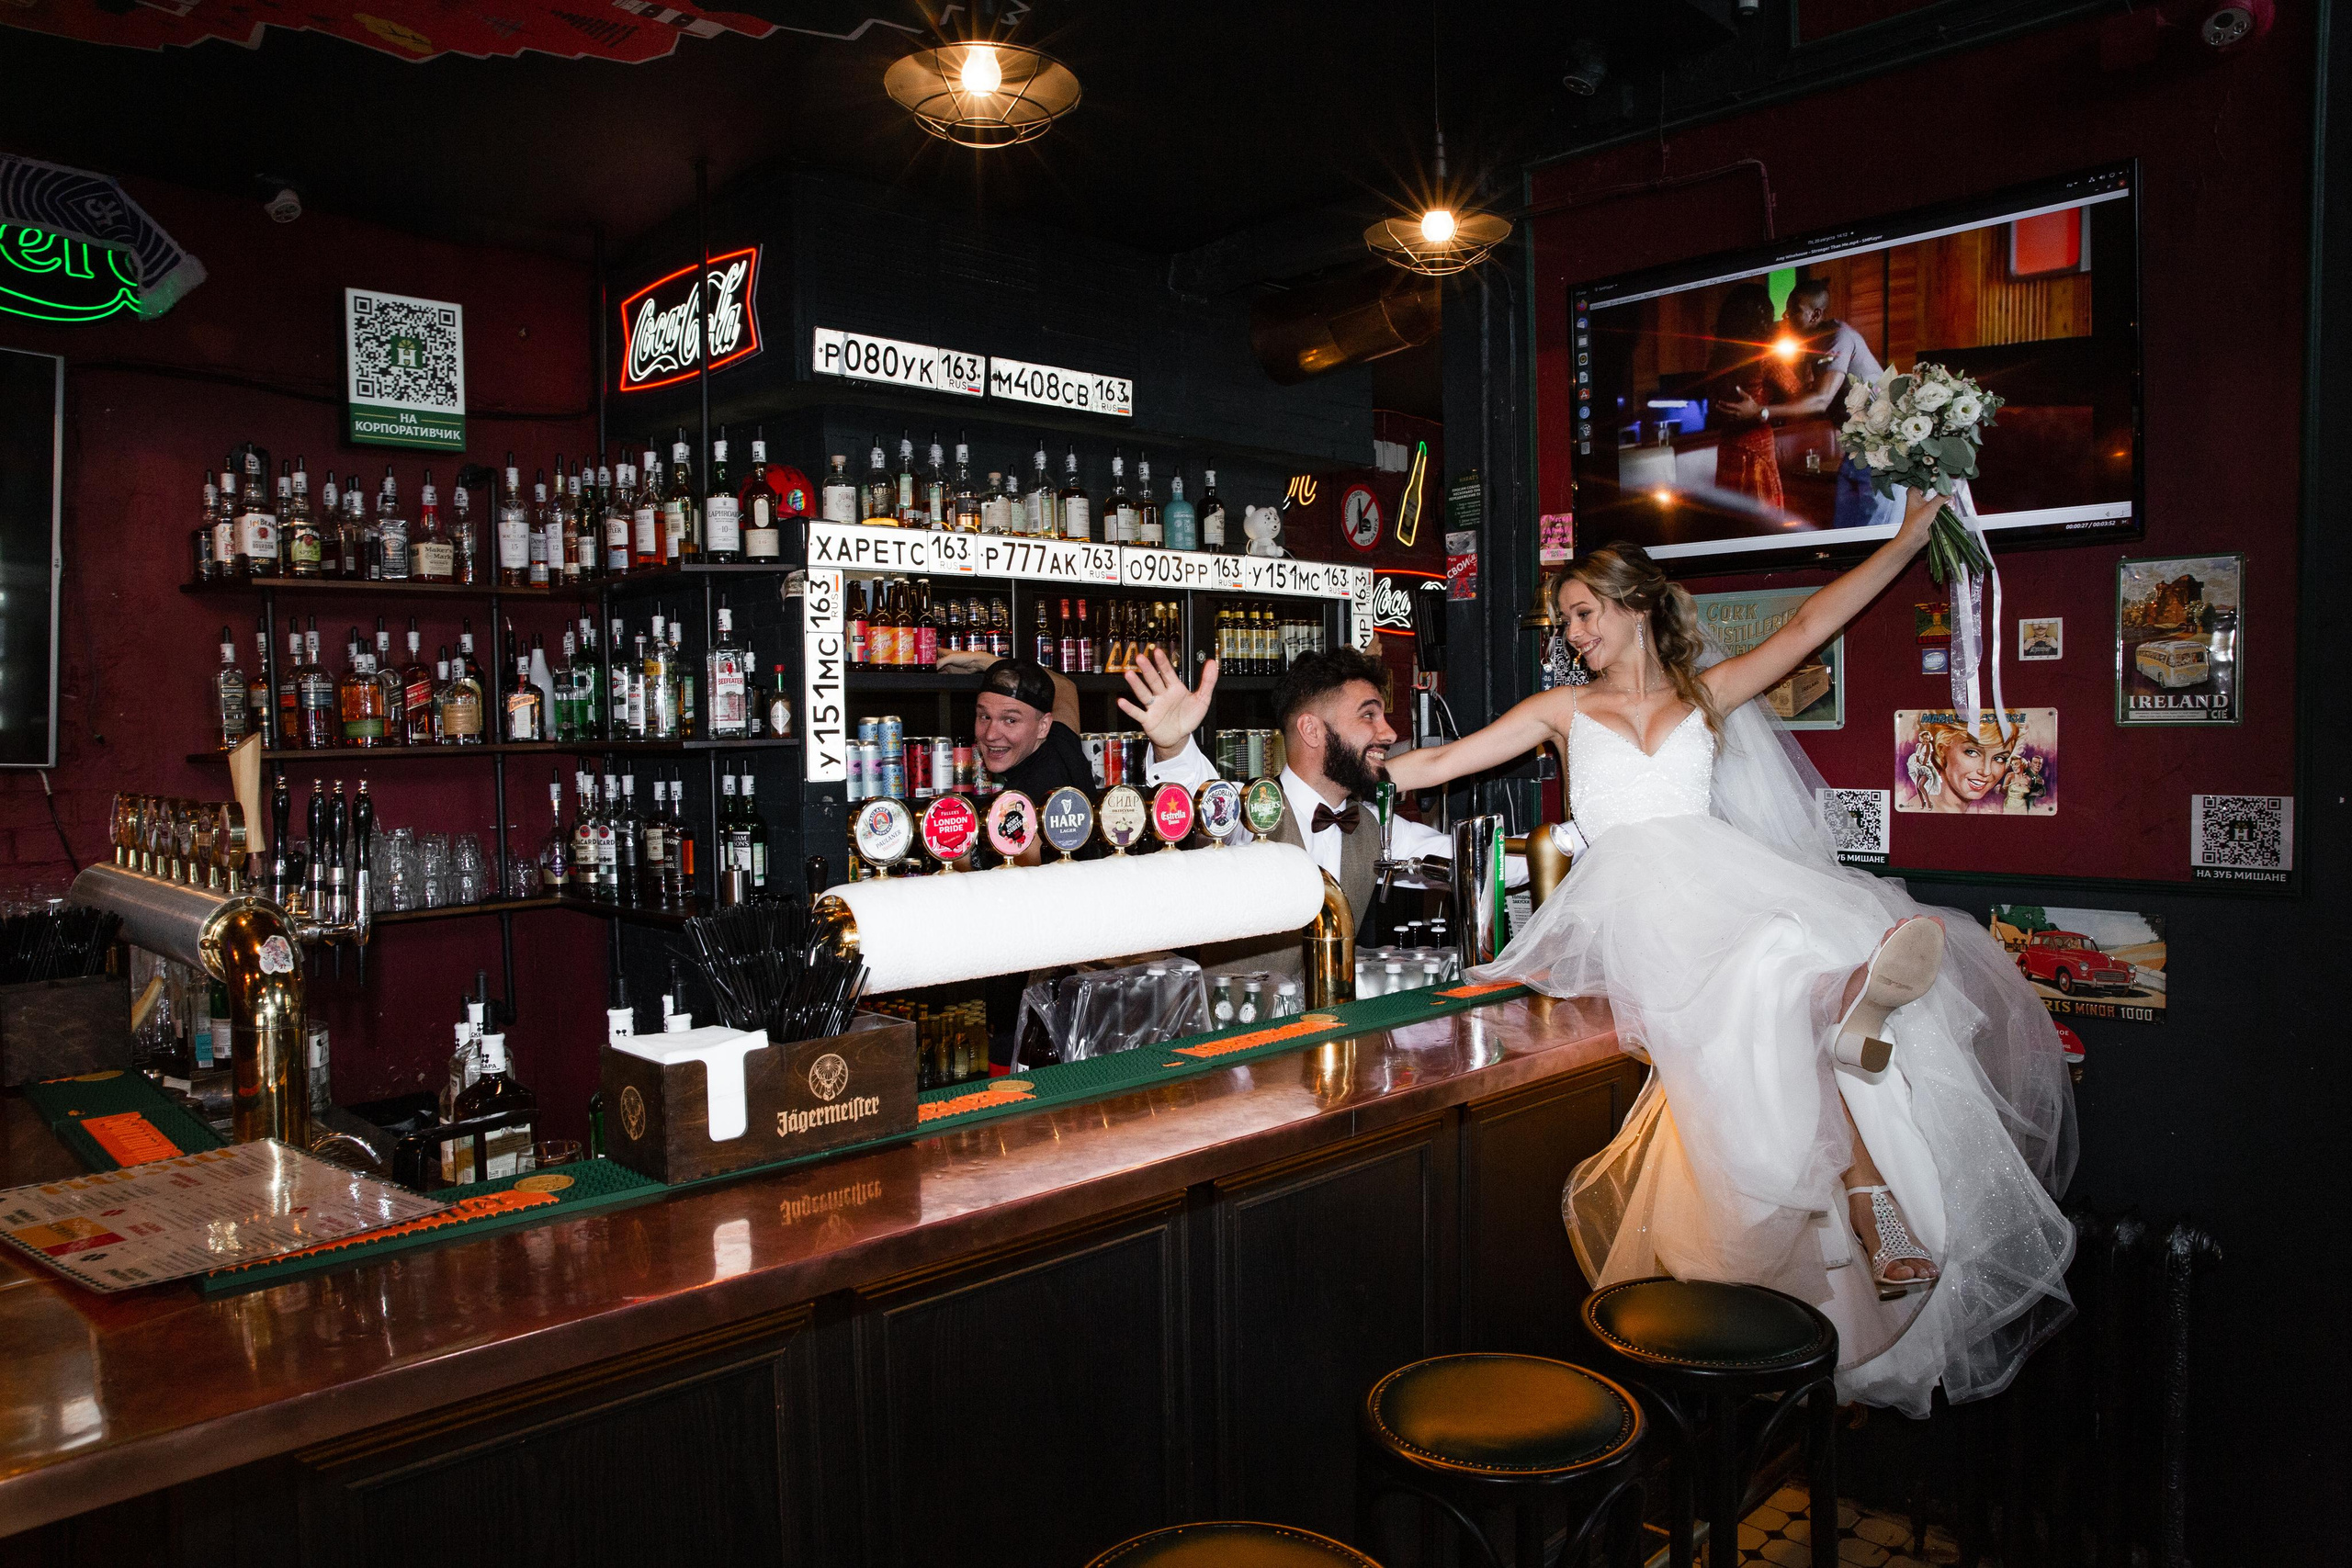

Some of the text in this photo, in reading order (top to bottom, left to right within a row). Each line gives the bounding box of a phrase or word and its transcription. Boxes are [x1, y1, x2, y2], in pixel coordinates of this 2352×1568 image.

[941, 354, 978, 382] 163
[948, 378, 967, 390] RUS
[1094, 378, 1127, 403] 163
[1101, 402, 1118, 412] RUS
[399, 413, 418, 424] НА
[355, 421, 461, 440] КОРПОРАТИВЧИК
[720, 524, 729, 534] 10
[931, 536, 967, 560] 163
[1081, 547, 1114, 570] 763
[1089, 570, 1106, 580] RUS
[1214, 557, 1240, 579] 163
[1218, 579, 1232, 588] RUS
[1323, 567, 1348, 588] 163
[1355, 575, 1367, 613] 163
[809, 580, 831, 628] 163
[1707, 603, 1759, 623] CORK
[718, 677, 744, 685] BEEFEATER
[2128, 694, 2229, 709] IRELAND
[2211, 709, 2228, 719] CIE
[1107, 795, 1140, 808] СИДР
[933, 816, 968, 828] LONDON
[1049, 812, 1086, 829] HARP
[1160, 809, 1187, 822] Estrella
[938, 823, 965, 835] PRIDE
[875, 829, 902, 850] PAULANER
[1847, 854, 1885, 863] МИШАНЕ
[2197, 869, 2287, 883] НА ЗУБ МИШАНЕ
[2075, 1002, 2115, 1018] MINOR
[2120, 1007, 2154, 1021] 1000
